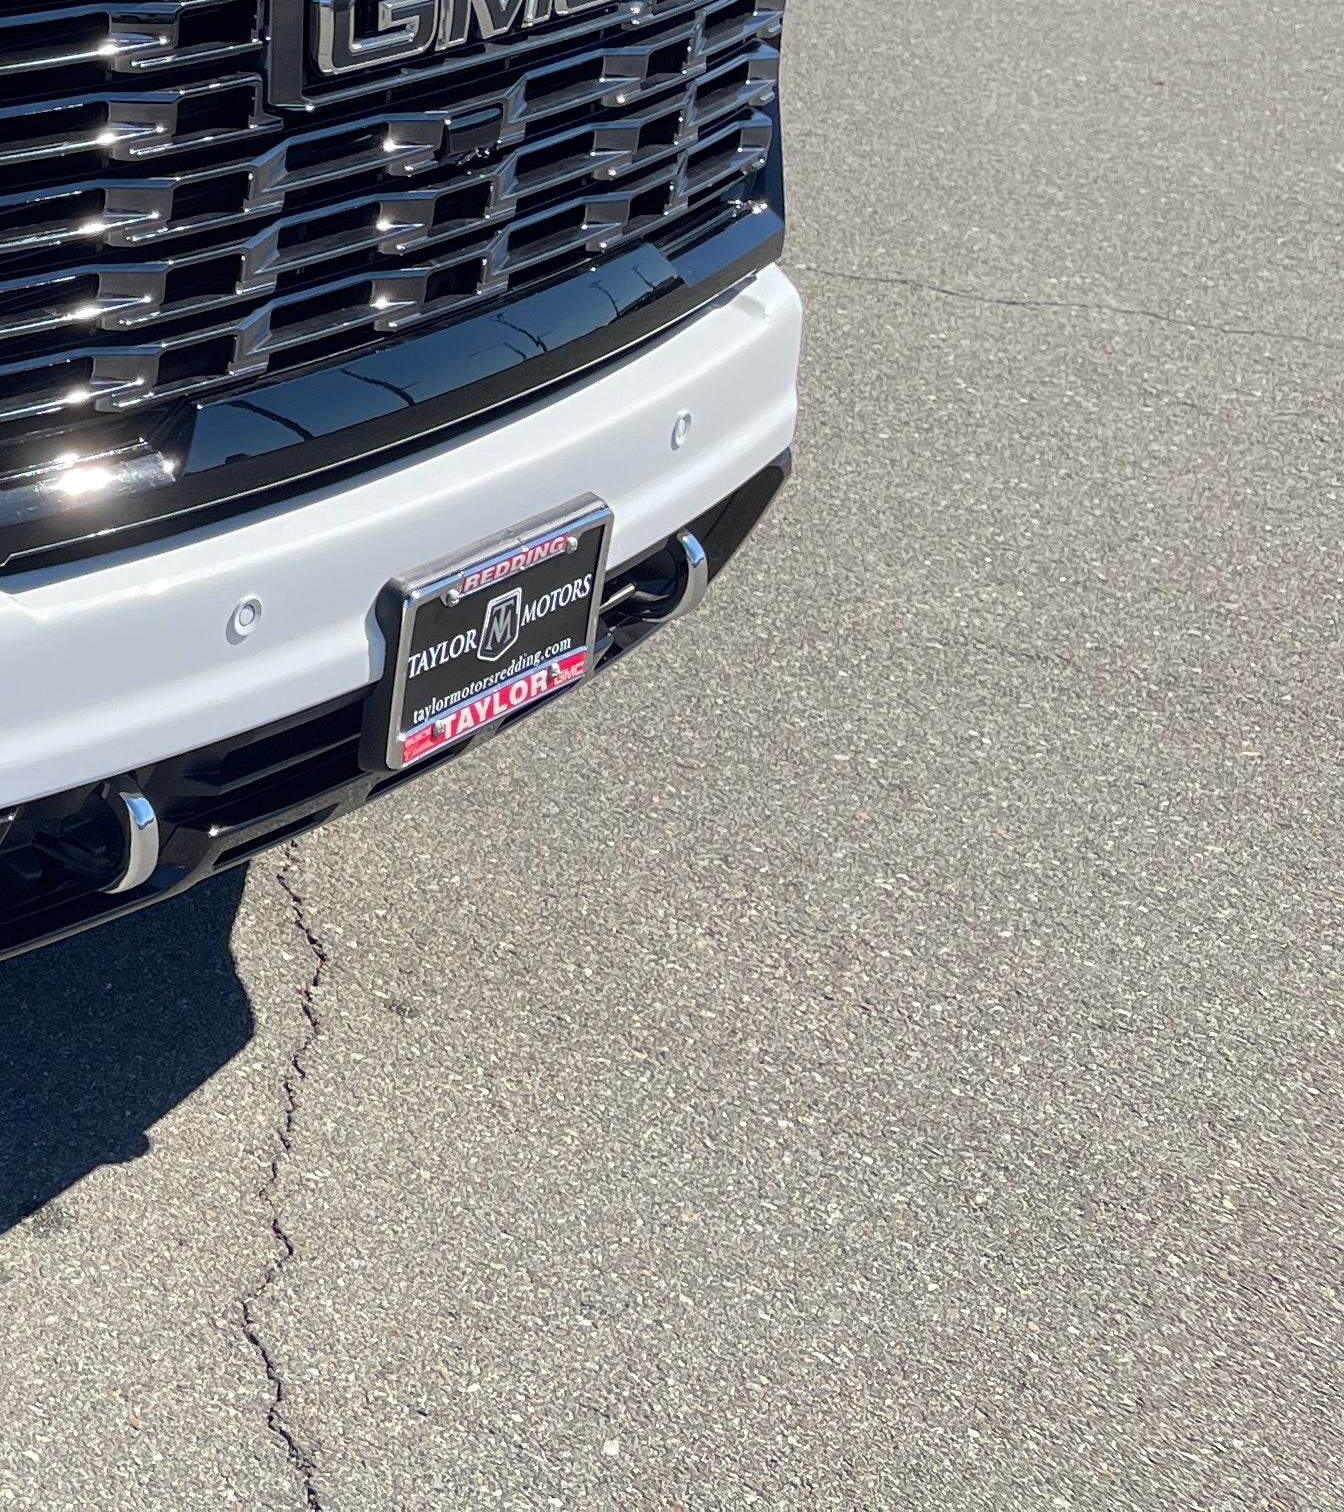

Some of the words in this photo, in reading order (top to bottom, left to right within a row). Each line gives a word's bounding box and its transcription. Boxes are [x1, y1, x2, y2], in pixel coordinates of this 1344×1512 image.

[464, 536, 566, 592] REDDING
[520, 573, 593, 627] MOTORS
[407, 628, 478, 679] TAYLOR
[413, 636, 572, 724] taylormotorsredding.com
[441, 669, 549, 740] TAYLOR
